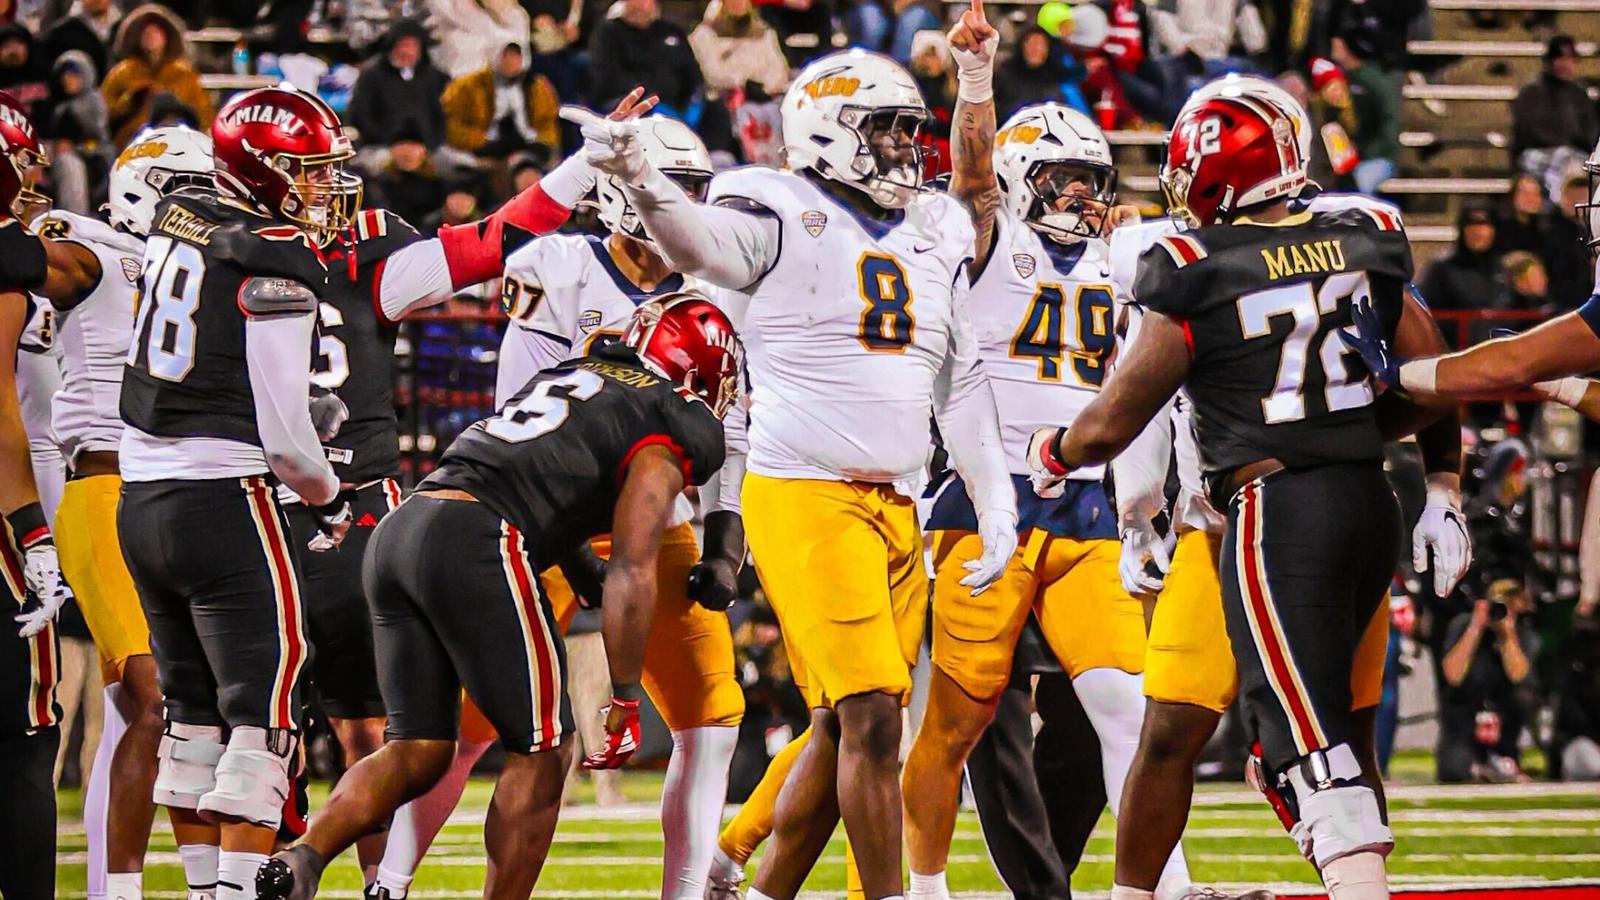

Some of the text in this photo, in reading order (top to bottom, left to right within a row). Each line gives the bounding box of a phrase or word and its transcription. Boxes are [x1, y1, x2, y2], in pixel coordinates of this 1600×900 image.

[235, 105, 304, 135] MIAMI
[1180, 116, 1221, 161] 72
[501, 276, 544, 320] 97
[1261, 240, 1346, 280] MANU
[126, 235, 206, 382] 78
[856, 252, 916, 354] 8
[1008, 282, 1118, 388] 49
[1236, 270, 1374, 425] 72
[485, 367, 604, 443] 6
